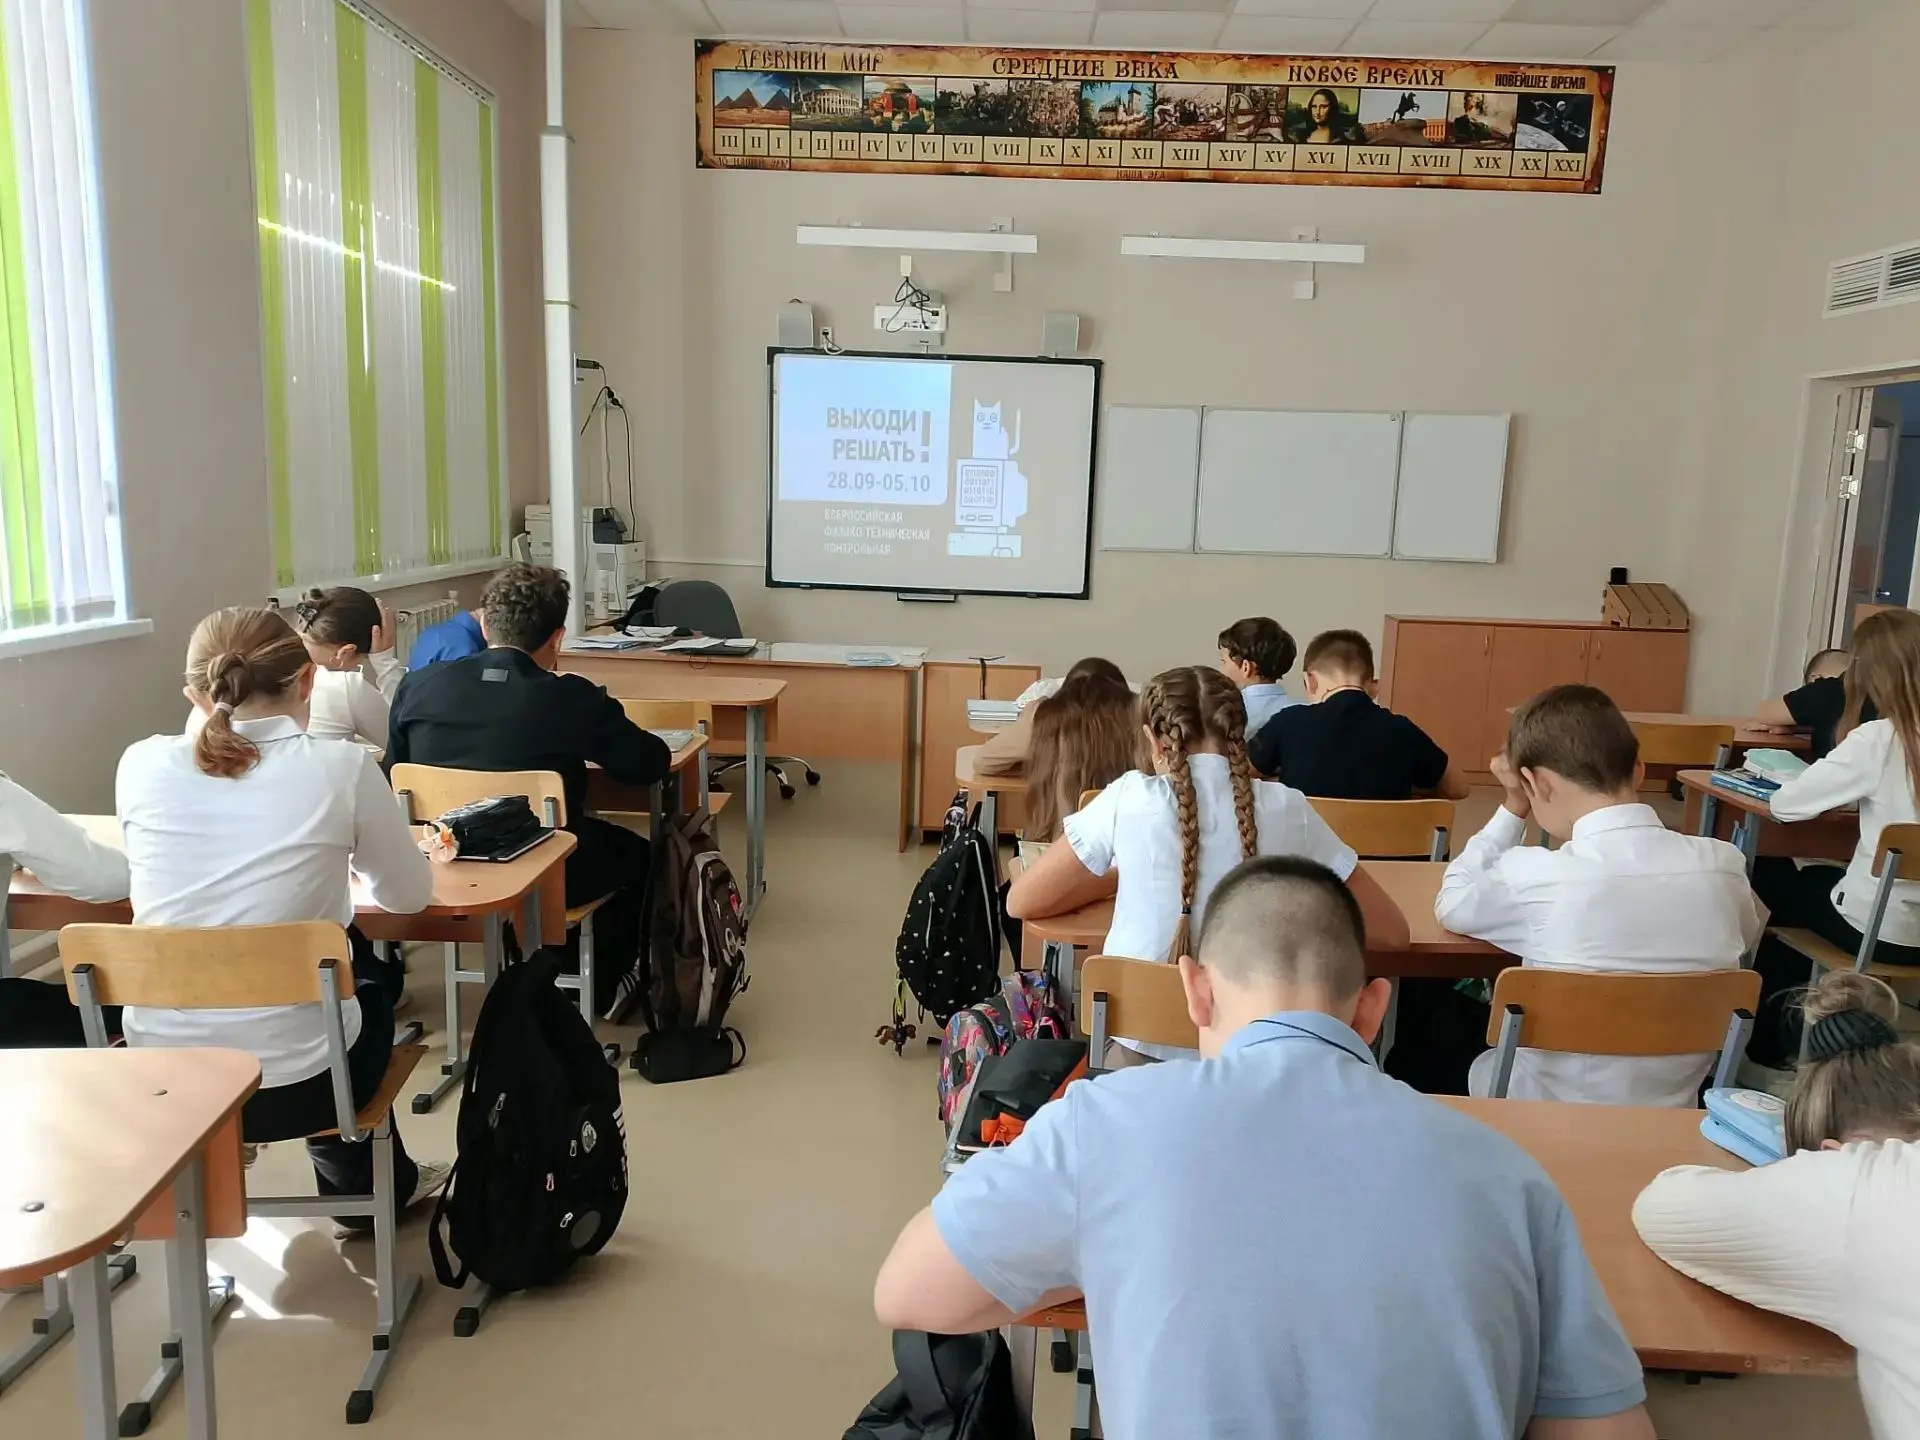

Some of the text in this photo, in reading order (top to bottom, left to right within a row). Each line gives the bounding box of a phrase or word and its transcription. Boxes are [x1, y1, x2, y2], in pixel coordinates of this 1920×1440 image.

[841, 51, 883, 72] МИР
[992, 57, 1180, 79] СРЕДНИЕ ВЕКА
[1287, 64, 1446, 86] НОВОЕ ВРЕМЯ
[1494, 72, 1586, 90] НОВЕЙШЕЕ ВРЕМЯ
[721, 135, 738, 148] III
[751, 136, 762, 149] II
[816, 138, 827, 151] II
[838, 139, 855, 152] III
[866, 139, 883, 153] IV
[921, 141, 936, 154] VI
[952, 142, 974, 155] VII
[993, 143, 1020, 157] VIII
[1040, 144, 1056, 158] IX
[1096, 146, 1113, 159] XI
[1131, 147, 1154, 160] XII
[1171, 148, 1200, 161] XIII
[1218, 149, 1247, 162] XIV
[1264, 150, 1287, 163] XV
[1307, 151, 1335, 165] XVI
[1356, 152, 1391, 166] XVII
[1410, 154, 1451, 168] XVIII
[1473, 156, 1502, 169] XIX
[1520, 157, 1542, 171] XX
[1553, 158, 1581, 172] XXI
[826, 407, 916, 435] ВЫХОДИ
[833, 438, 915, 462] РЕШАТЬ
[827, 471, 931, 492] 28.09-05.10
